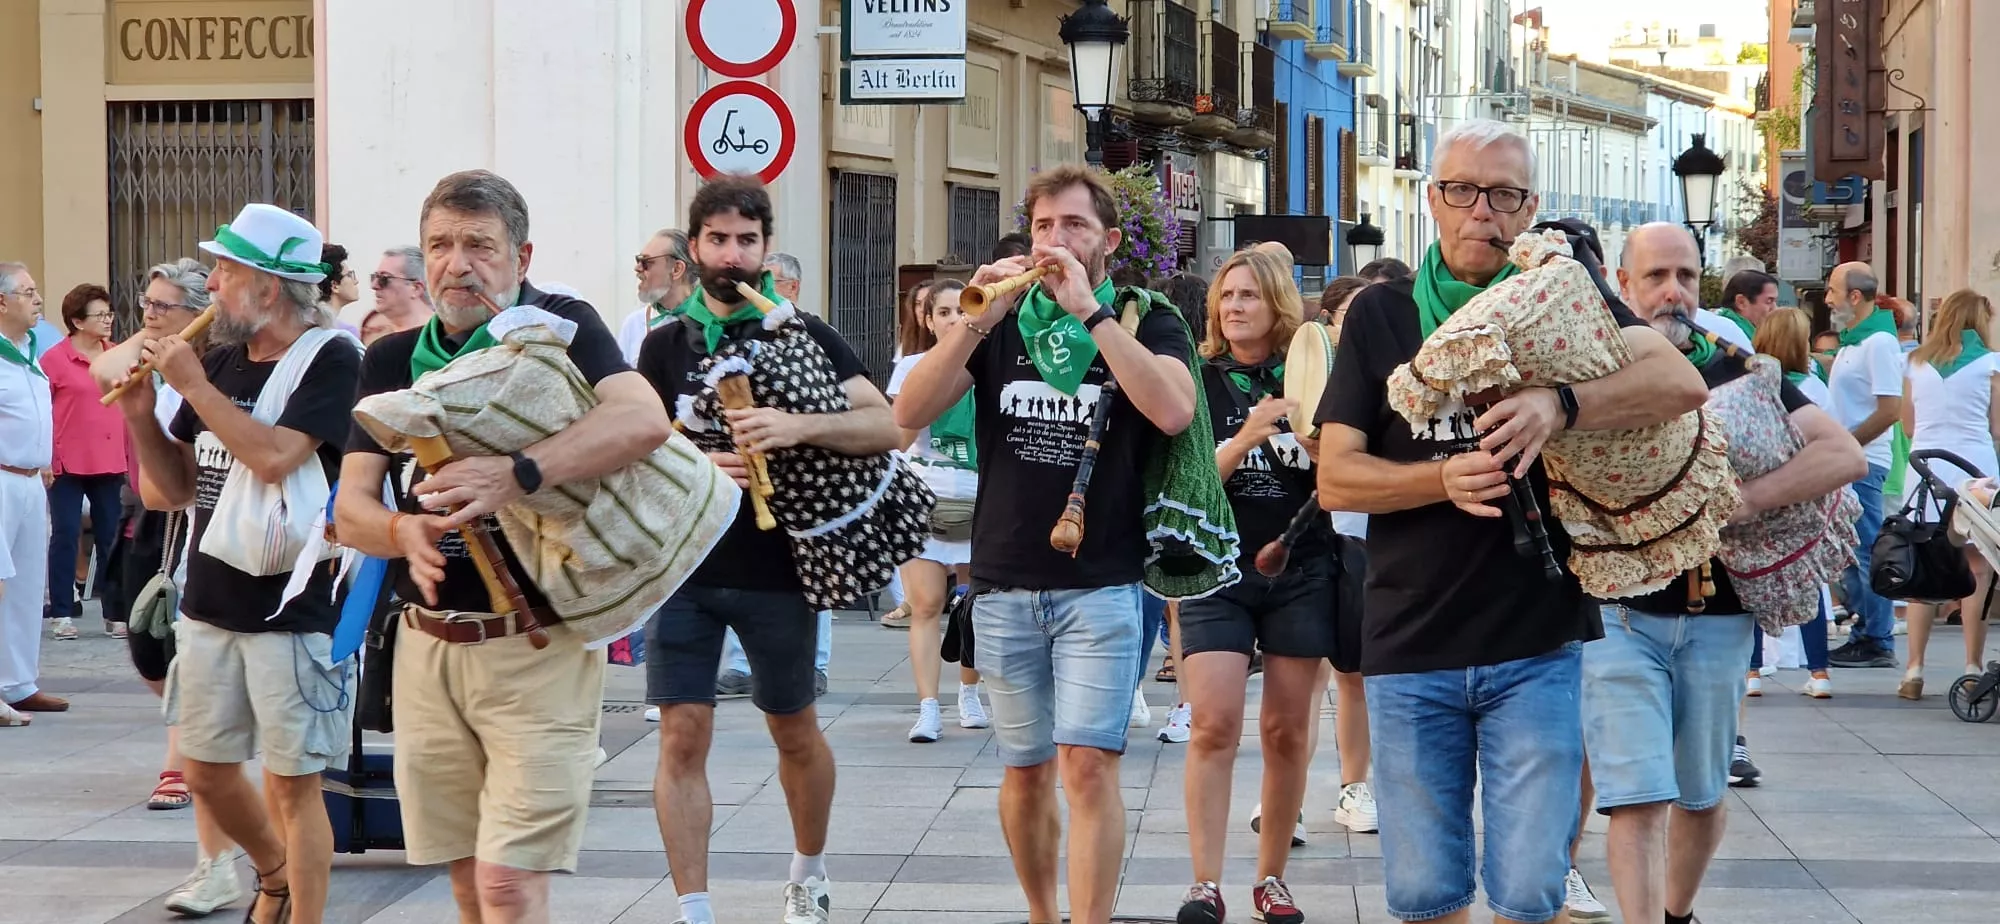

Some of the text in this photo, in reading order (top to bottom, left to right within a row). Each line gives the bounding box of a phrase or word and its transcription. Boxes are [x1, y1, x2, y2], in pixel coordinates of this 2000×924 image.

[858, 68, 956, 89] Alt Berlin
[1056, 422, 1076, 432] Spain
